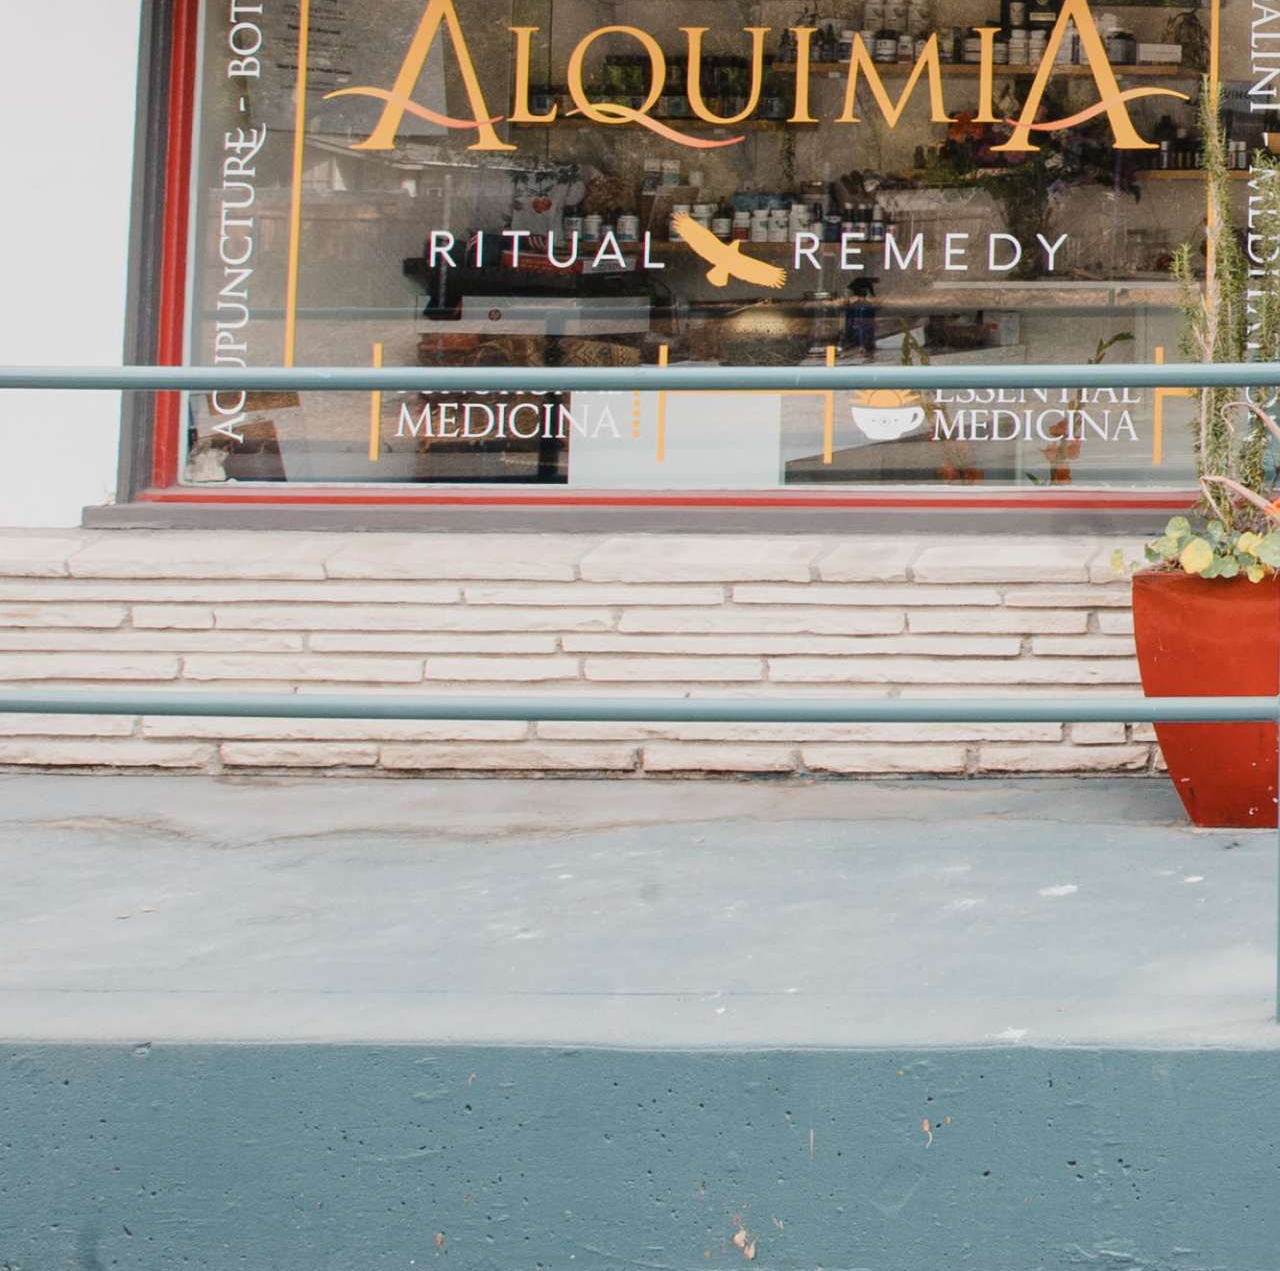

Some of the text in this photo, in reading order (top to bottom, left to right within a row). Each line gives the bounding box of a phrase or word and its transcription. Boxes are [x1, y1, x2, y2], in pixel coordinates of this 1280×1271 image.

[430, 230, 1069, 272] RITUAL REMEDY
[394, 402, 622, 439] MEDICINA
[931, 408, 1140, 442] MEDICINA
